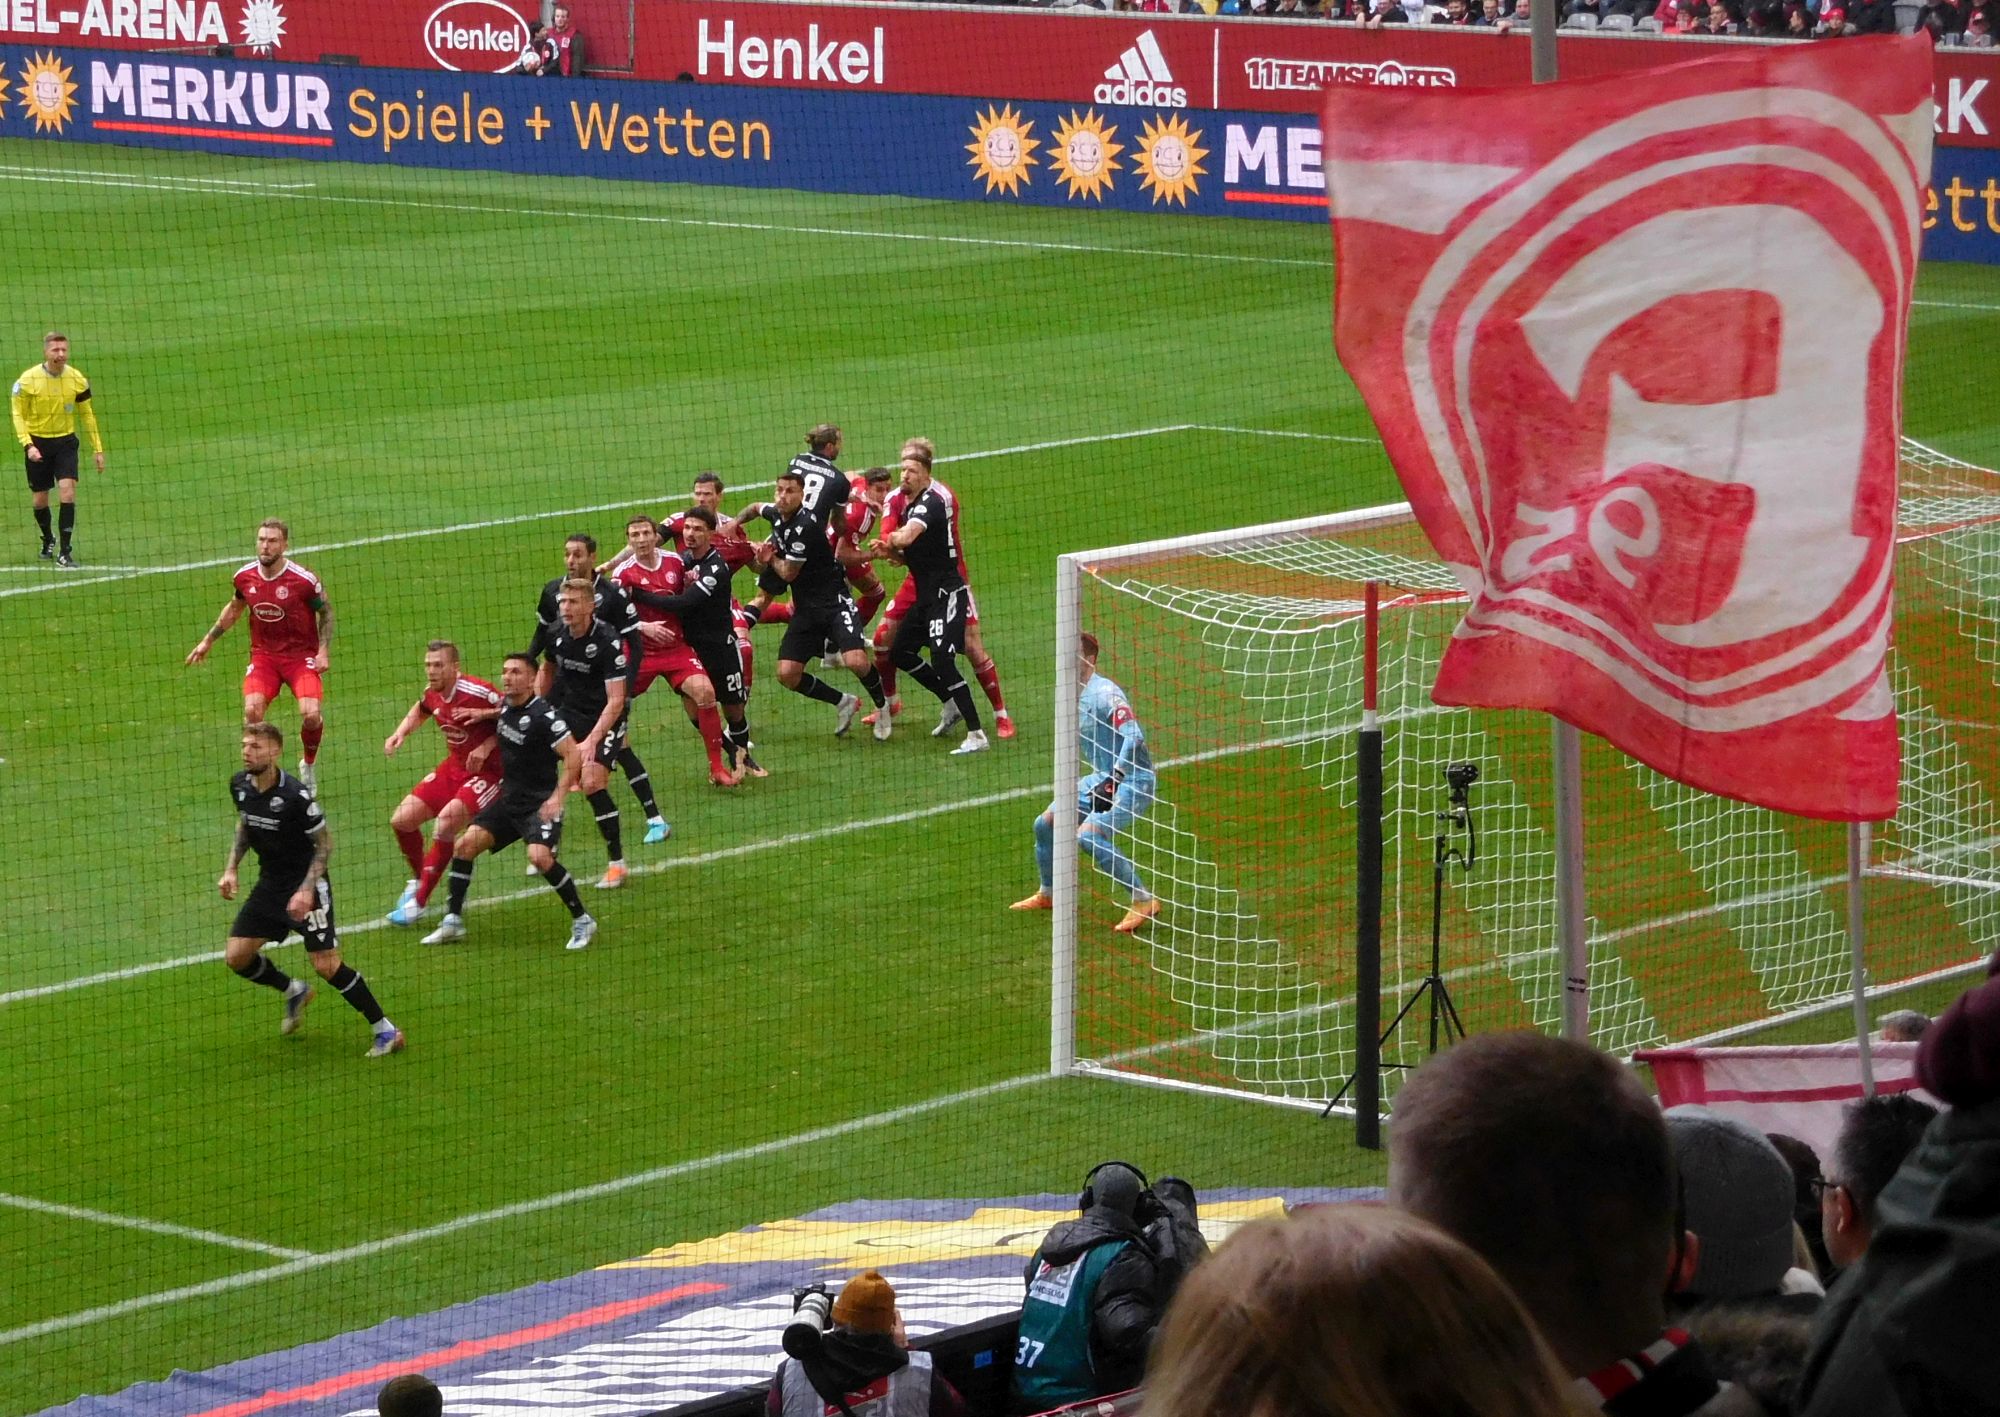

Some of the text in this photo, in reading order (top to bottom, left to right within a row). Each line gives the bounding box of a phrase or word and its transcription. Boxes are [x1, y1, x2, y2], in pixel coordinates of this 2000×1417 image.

[434, 21, 520, 52] Henkel
[698, 19, 884, 84] Henkel
[1094, 79, 1188, 107] adidas
[91, 61, 771, 161] MERKUR Spiele + Wetten
[802, 473, 825, 510] 8
[841, 611, 853, 625] 3
[929, 619, 944, 637] 26
[726, 672, 742, 692] 20
[303, 909, 329, 932] 30
[1015, 1336, 1045, 1369] 37
